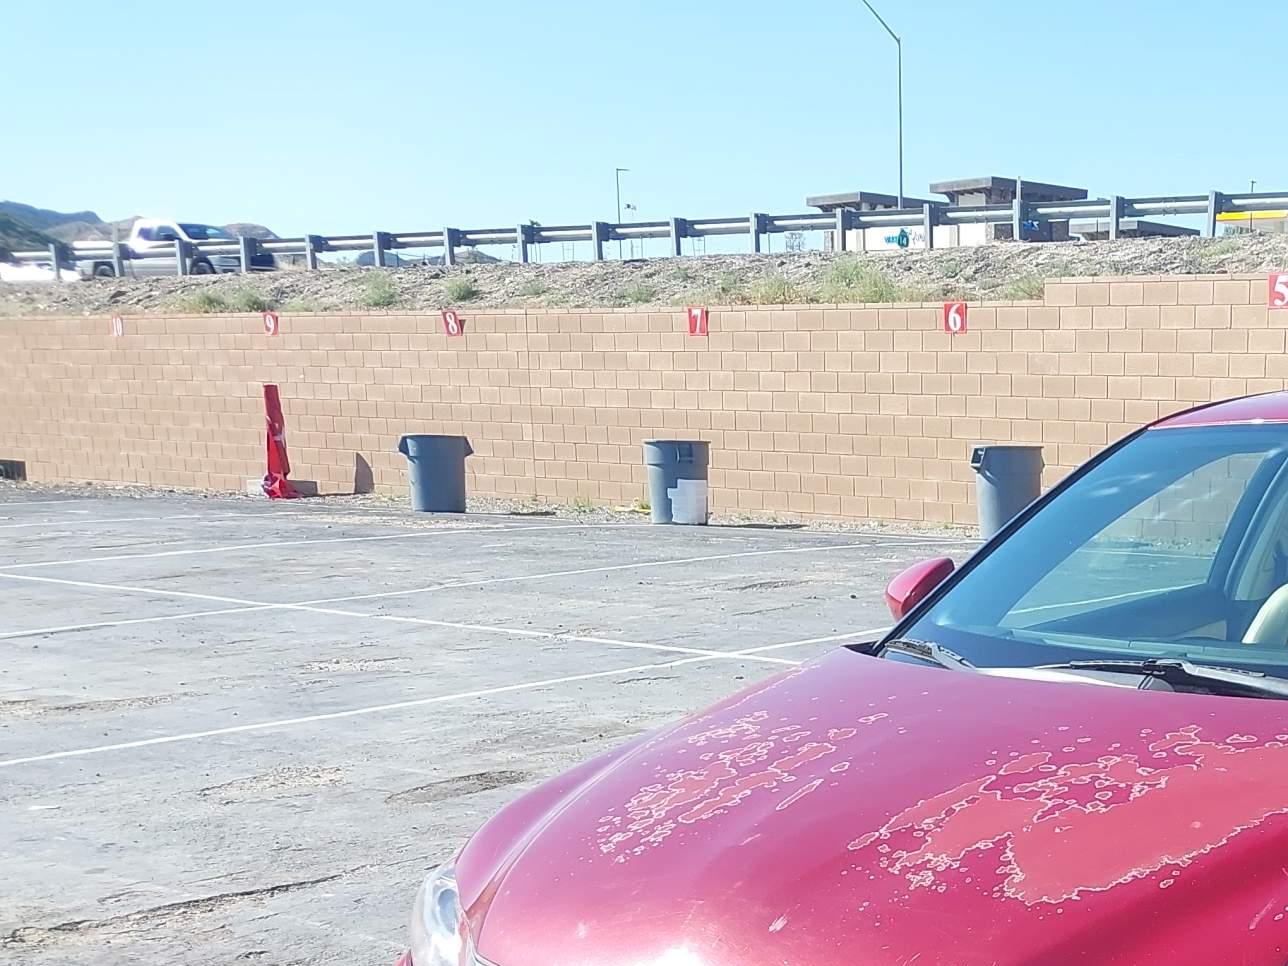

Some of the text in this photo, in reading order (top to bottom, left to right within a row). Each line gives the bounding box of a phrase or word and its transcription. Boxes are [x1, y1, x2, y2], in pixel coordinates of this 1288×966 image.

[111, 316, 123, 337] 10
[265, 313, 275, 336] 9
[446, 312, 457, 335] 8
[690, 309, 702, 335] 7
[947, 303, 962, 331] 6
